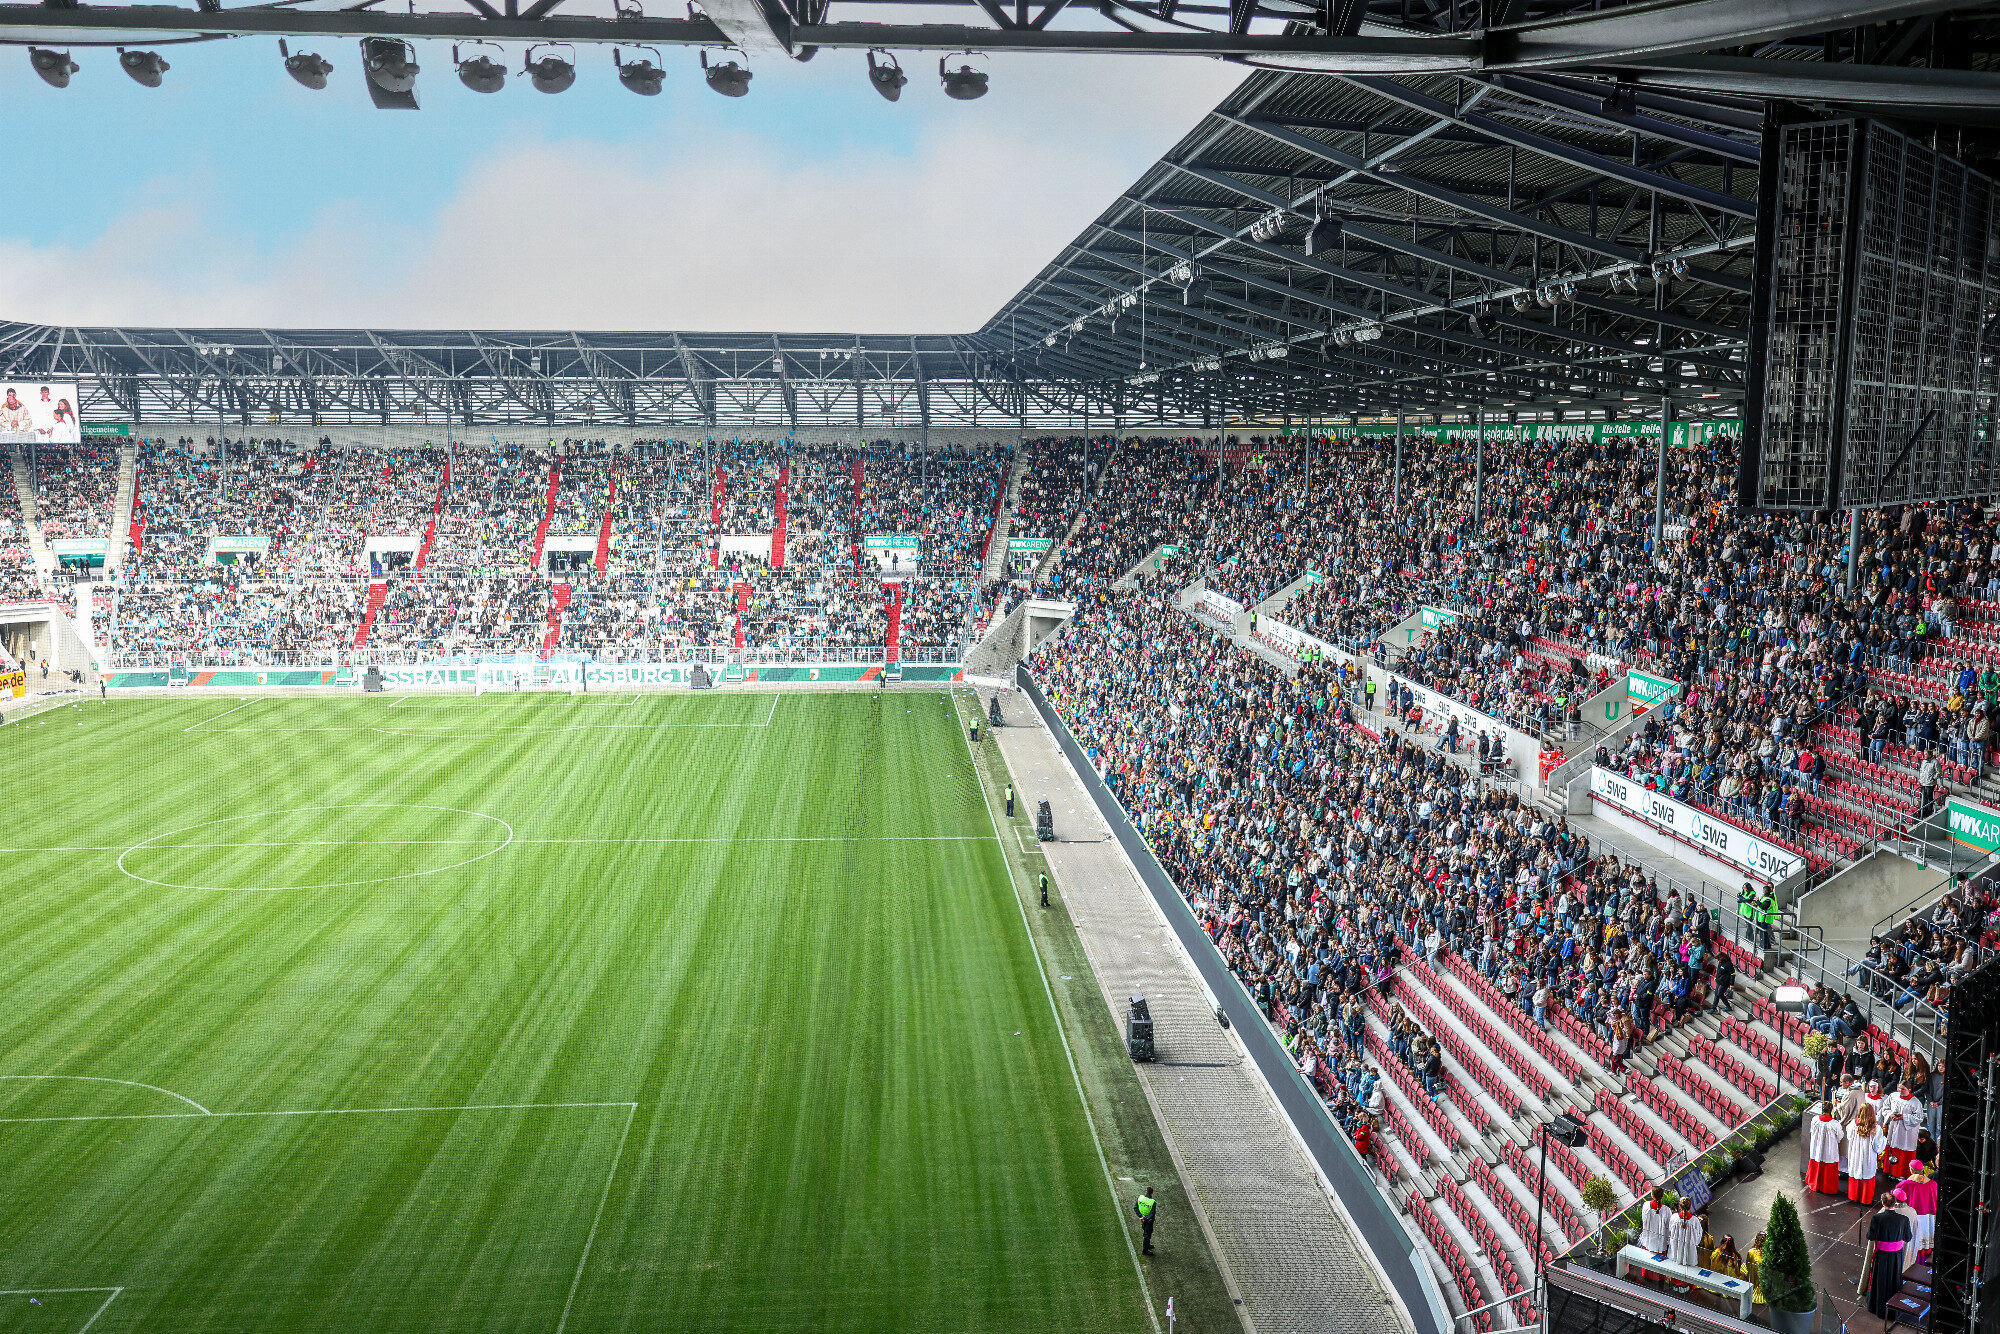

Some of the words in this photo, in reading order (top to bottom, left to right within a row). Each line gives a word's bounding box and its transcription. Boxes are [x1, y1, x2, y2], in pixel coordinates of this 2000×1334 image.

[1536, 425, 1595, 443] KASTNER
[1405, 628, 1416, 643] T
[1604, 701, 1620, 720] U
[1606, 779, 1627, 801] swa
[1651, 800, 1675, 824] swa
[1702, 824, 1728, 850] swa
[1760, 851, 1788, 880] swa
